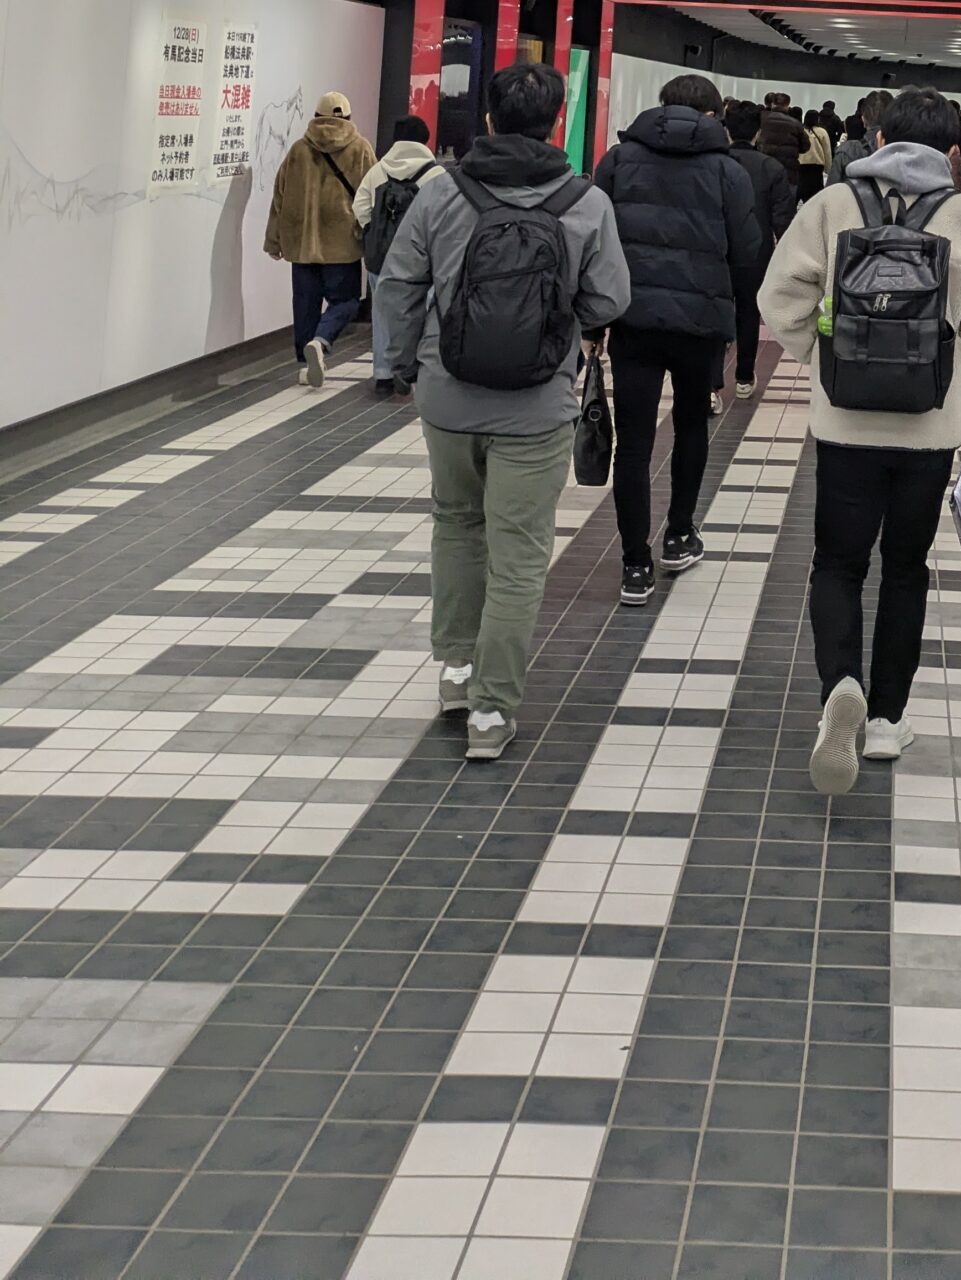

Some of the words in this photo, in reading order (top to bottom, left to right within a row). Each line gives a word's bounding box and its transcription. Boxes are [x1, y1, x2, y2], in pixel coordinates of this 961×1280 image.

[173, 26, 200, 44] 12/28(日)
[163, 43, 204, 64] 有馬記念当日
[221, 83, 251, 110] 大混雑
[152, 167, 196, 182] のみ入場可能です
